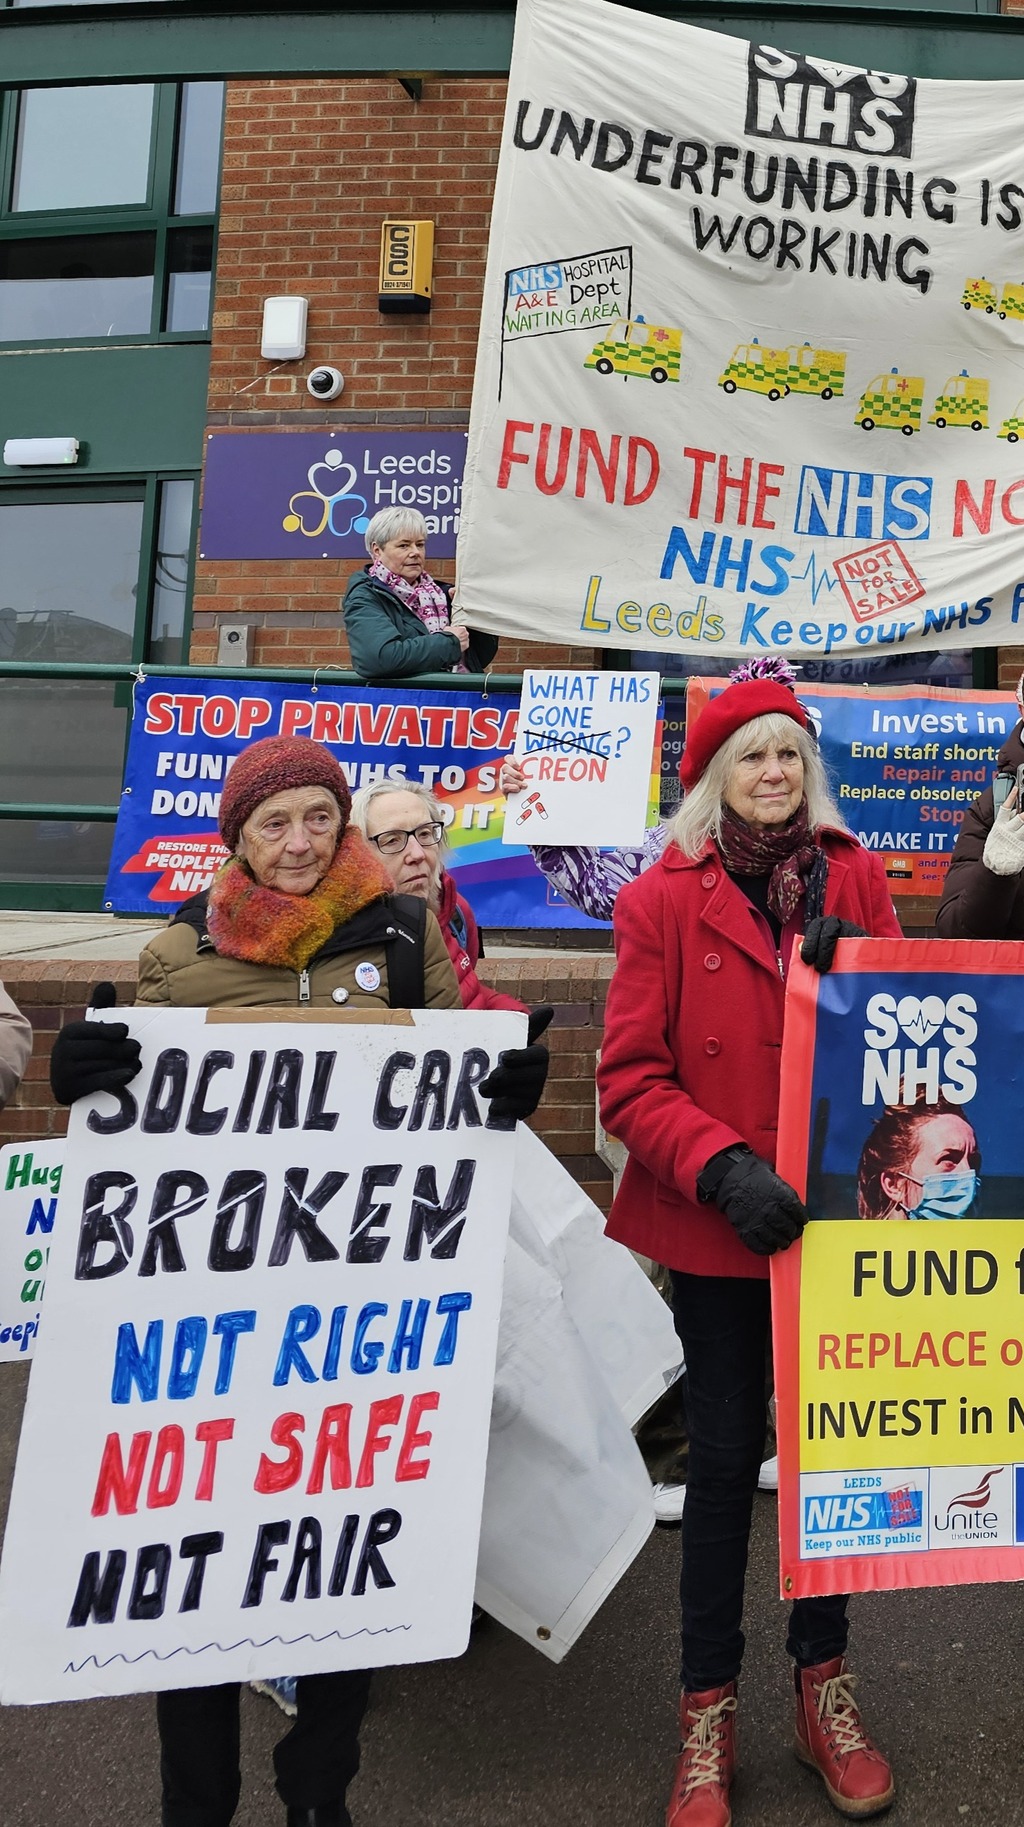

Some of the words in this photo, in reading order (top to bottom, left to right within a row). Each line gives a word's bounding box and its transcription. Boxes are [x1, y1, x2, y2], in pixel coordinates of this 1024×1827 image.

[757, 79, 903, 152] NHS
[513, 99, 957, 223] UNDERFUNDING
[388, 227, 410, 275] CSC
[692, 206, 932, 295] WORKING
[511, 264, 560, 295] NHS
[563, 254, 629, 282] HOSPITAL
[570, 277, 622, 305] Dept
[505, 309, 576, 334] WAITING
[580, 302, 622, 324] AREA
[363, 449, 452, 475] Leeds
[495, 419, 660, 508] FUND
[682, 447, 785, 530] THE
[795, 466, 932, 541] NHS
[658, 525, 794, 597] NHS
[844, 548, 893, 580] NOT
[856, 580, 917, 615] SALE
[861, 570, 897, 593] FOR
[580, 574, 725, 644] Leeds
[740, 603, 847, 656] Keep
[855, 620, 916, 645] our
[921, 596, 995, 637] NHS
[529, 674, 600, 702] WHAT
[608, 677, 651, 703] HAS
[144, 692, 272, 738] STOP
[527, 704, 594, 729] GONE
[871, 709, 969, 735] Invest
[977, 711, 1006, 734] in
[851, 741, 888, 759] End
[893, 743, 940, 761] staff
[418, 764, 466, 791] TO
[519, 756, 608, 783] CREON
[882, 764, 946, 785] Repair
[950, 766, 986, 782] and
[839, 784, 906, 802] Replace
[910, 785, 982, 802] obsolete
[461, 803, 495, 829] IT
[919, 805, 966, 827] Stop
[157, 841, 207, 853] RESTORE
[857, 831, 922, 850] MAKE
[928, 833, 948, 851] IT
[860, 1043, 979, 1107] NHS
[76, 1158, 477, 1281] BROKEN
[852, 1248, 1000, 1299] FUND
[110, 1308, 257, 1405] NOT
[272, 1291, 473, 1388] RIGHT
[816, 1330, 989, 1371] REPLACE
[806, 1398, 948, 1441] INVEST
[958, 1399, 995, 1437] in
[91, 1417, 236, 1517] NOT
[253, 1390, 441, 1495] SAFE
[843, 1476, 883, 1489] LEEDS
[805, 1495, 873, 1532] NHS
[934, 1510, 999, 1532] unite
[804, 1538, 833, 1552] Keep
[836, 1537, 855, 1548] our
[858, 1534, 882, 1546] NHS
[885, 1533, 923, 1547] public
[66, 1529, 225, 1629] NOT
[240, 1507, 403, 1609] FAIR
